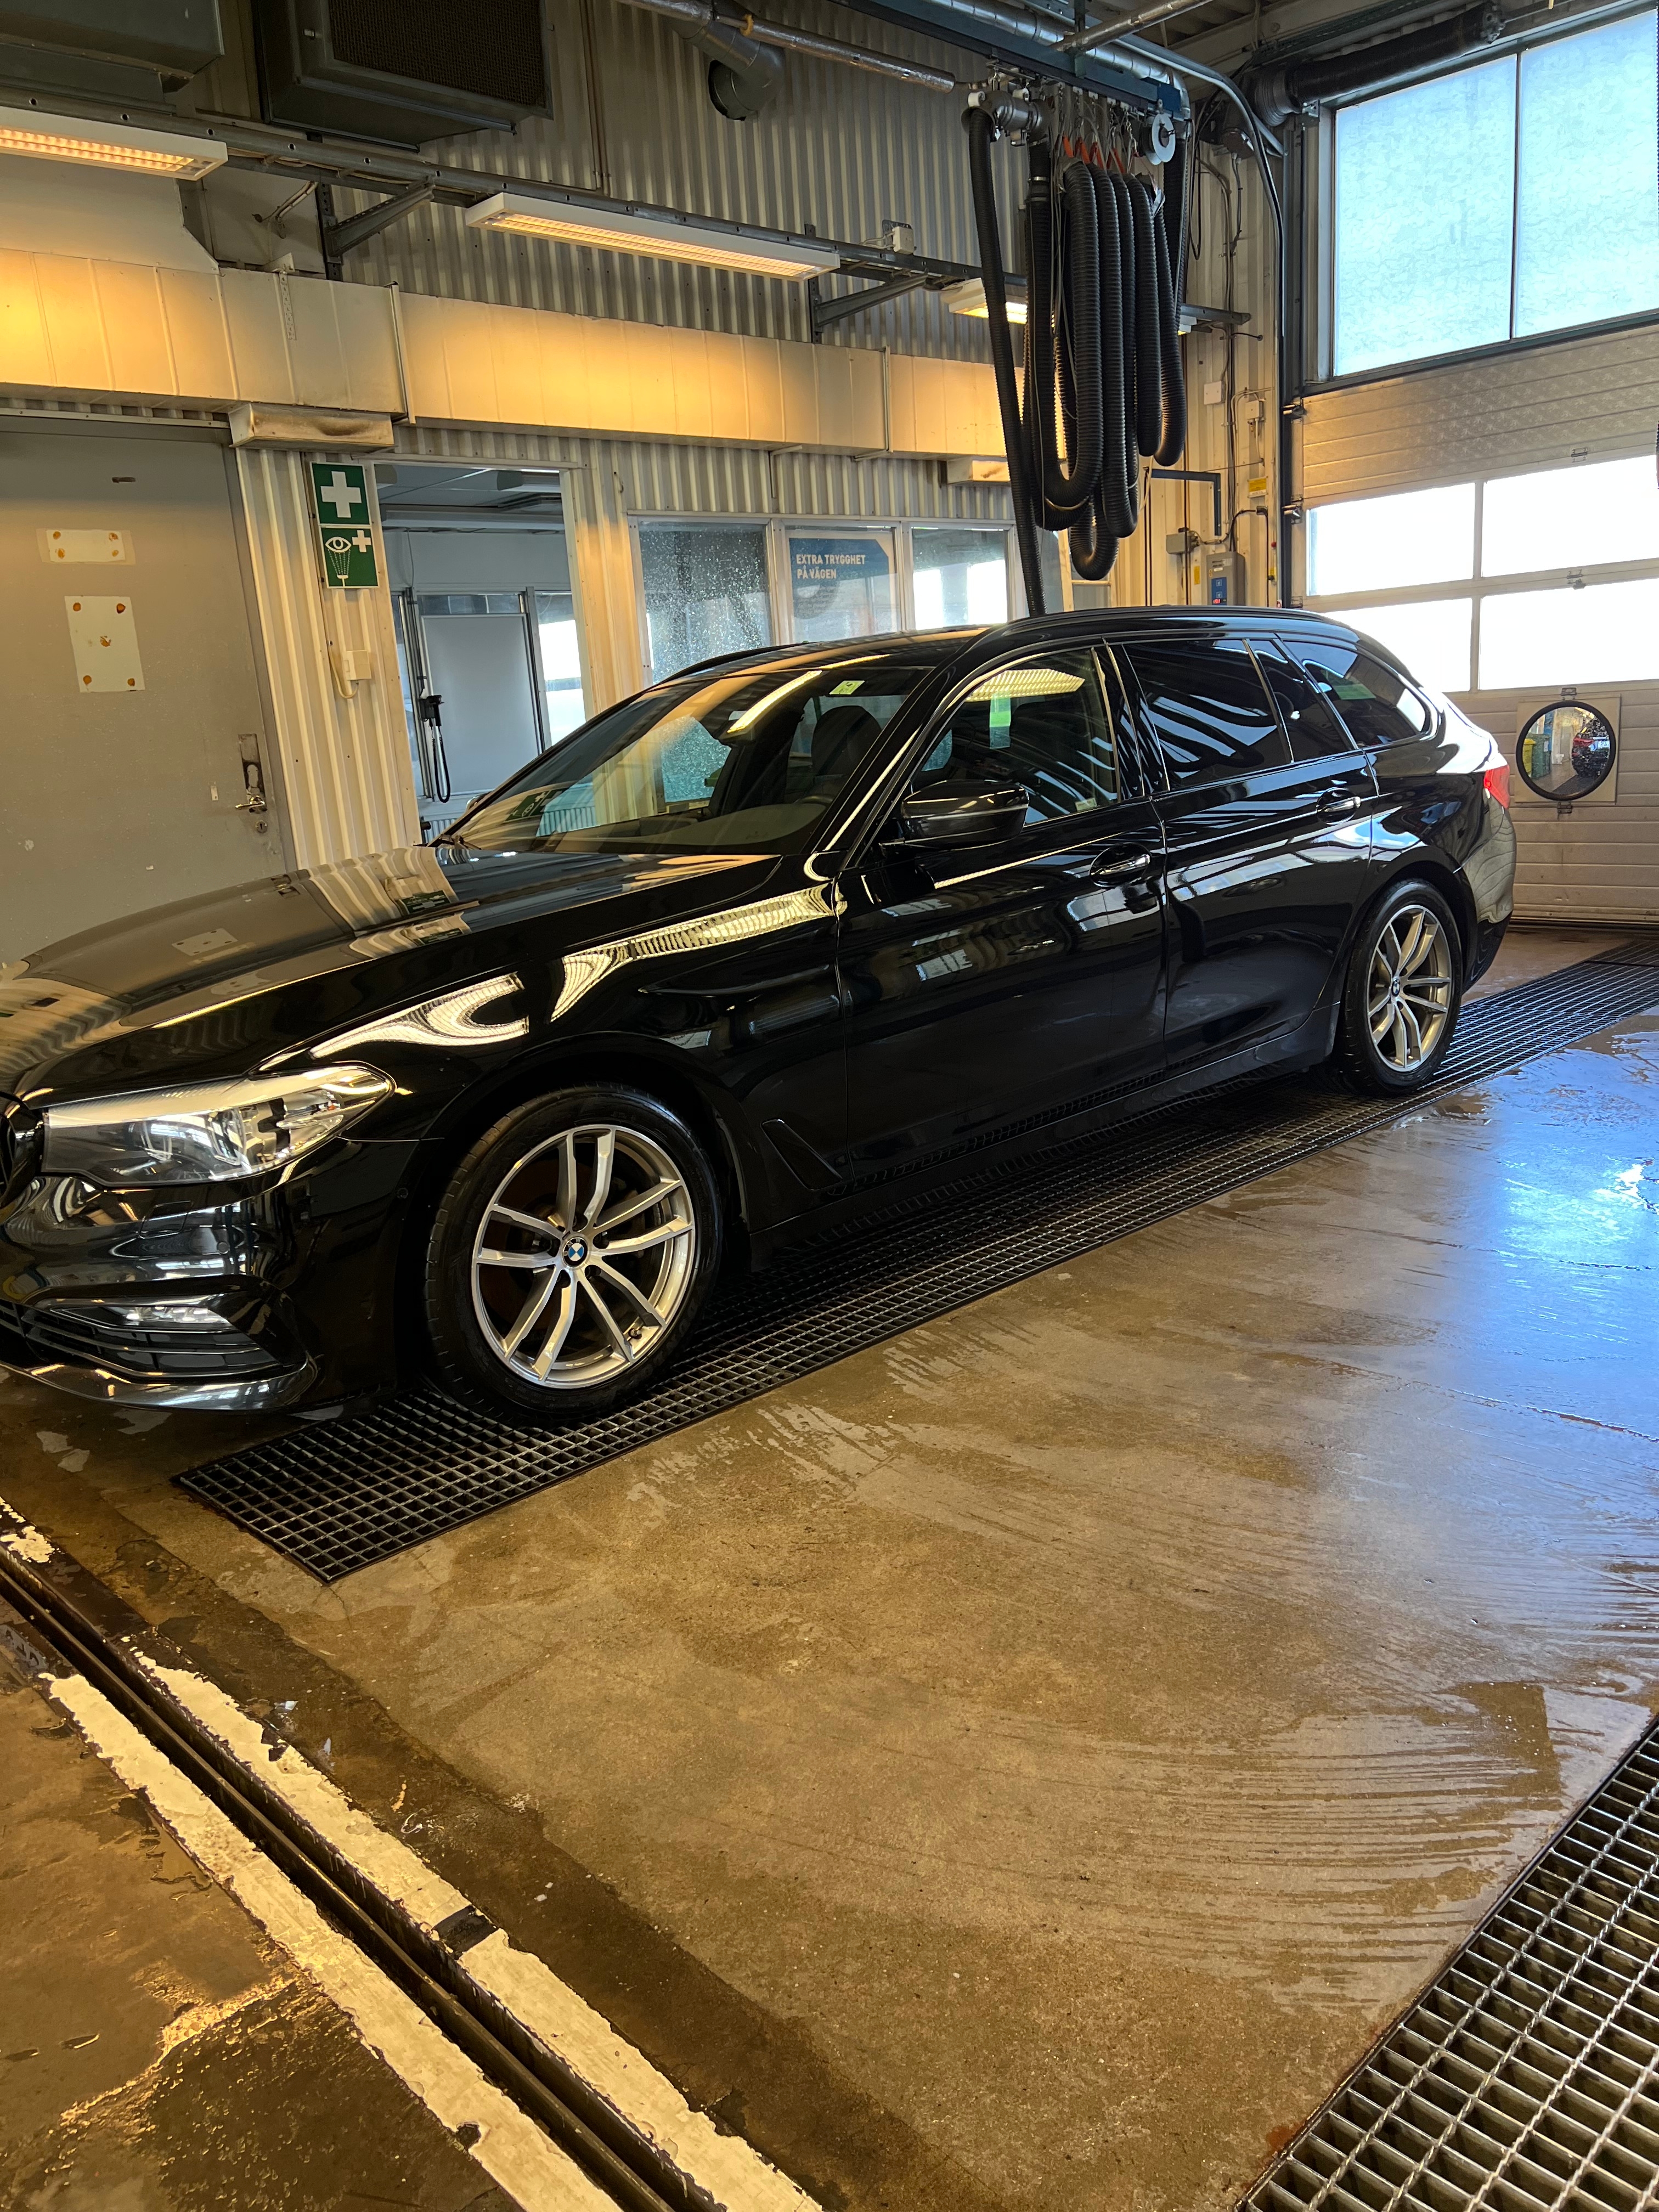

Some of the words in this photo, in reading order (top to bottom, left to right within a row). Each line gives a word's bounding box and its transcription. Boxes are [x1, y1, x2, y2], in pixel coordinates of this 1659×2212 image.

[797, 554, 823, 564] EXTRA
[825, 554, 865, 564] TRYGGHET
[797, 566, 808, 579] PÅ
[809, 567, 837, 579] VÄGEN
